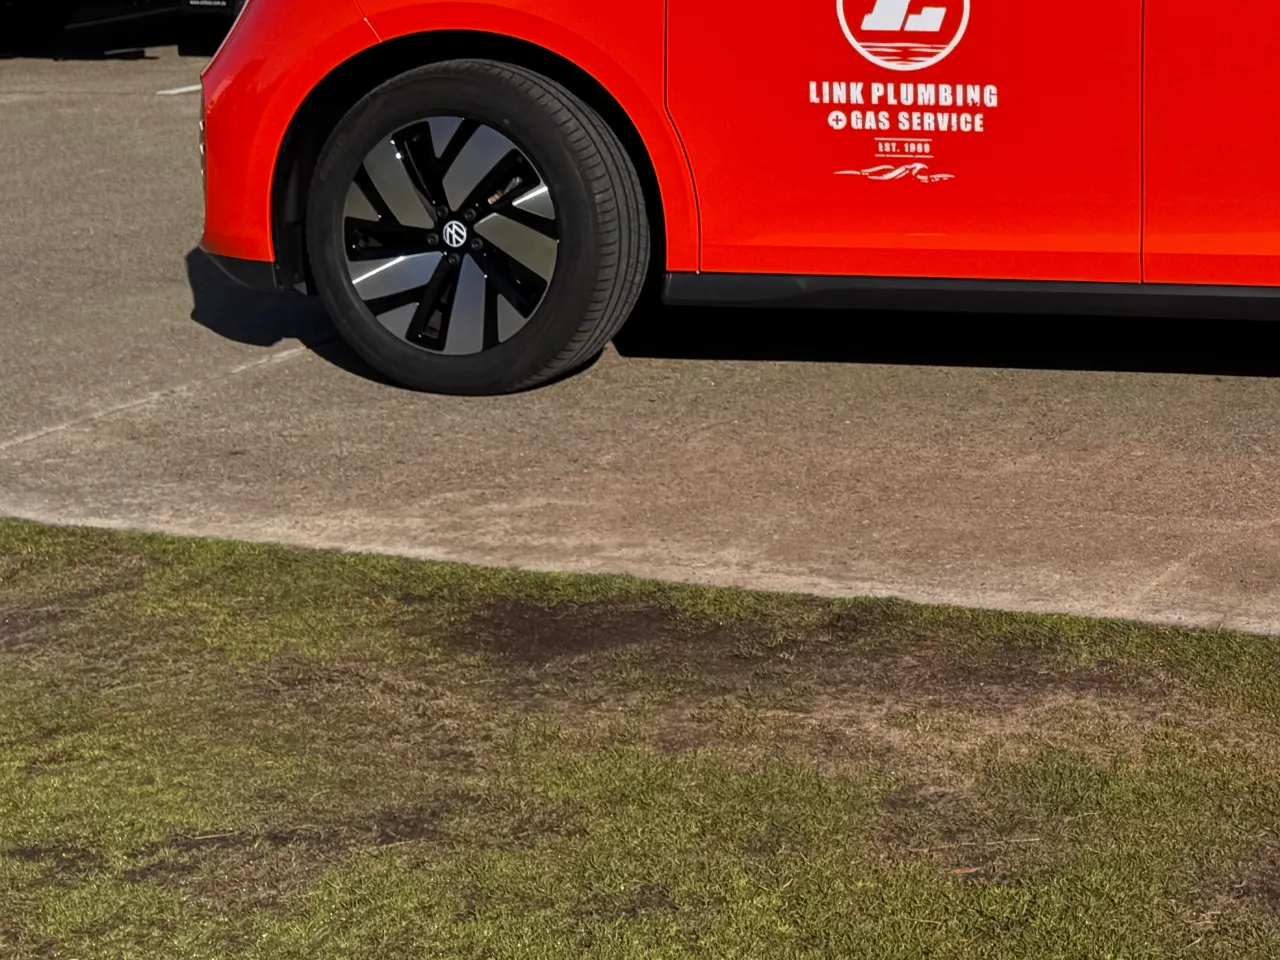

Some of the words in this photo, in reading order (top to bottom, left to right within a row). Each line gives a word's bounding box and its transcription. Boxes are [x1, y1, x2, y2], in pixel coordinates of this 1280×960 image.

[810, 82, 865, 104] LINK
[871, 83, 998, 107] PLUMBING
[898, 112, 984, 132] SERVICE
[878, 142, 900, 152] EST.
